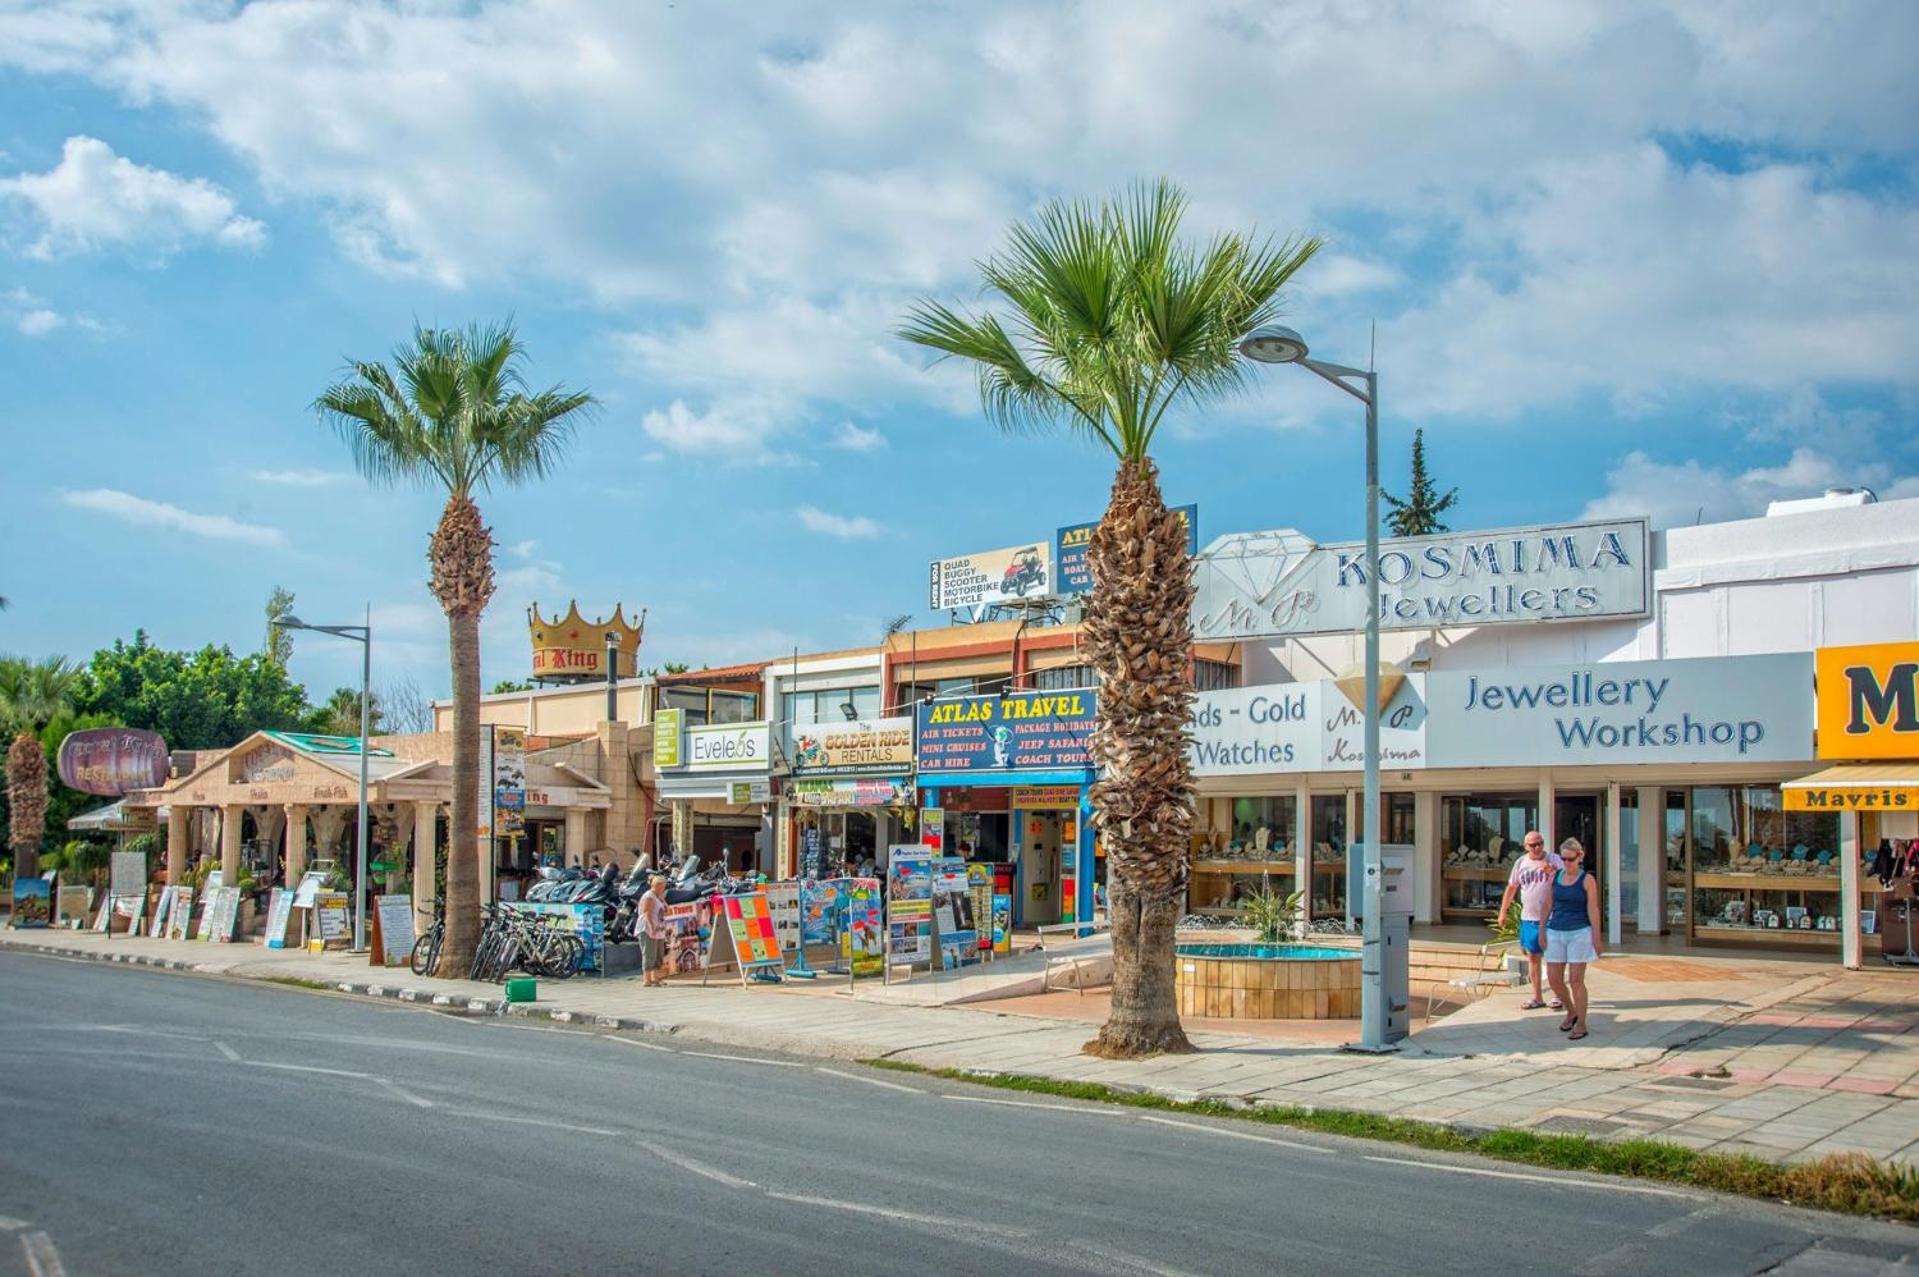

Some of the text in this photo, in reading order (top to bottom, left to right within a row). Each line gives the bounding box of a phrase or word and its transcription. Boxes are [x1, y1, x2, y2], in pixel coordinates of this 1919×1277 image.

[944, 559, 970, 571] QUAD
[1337, 531, 1630, 588] KOSMIMA
[944, 567, 977, 580] BUGGY
[944, 575, 988, 589] SCOOTER
[944, 582, 999, 598] MOTORBIKE
[944, 594, 983, 607] BICYCLE
[1379, 583, 1598, 620] Jewellers
[552, 648, 598, 670] King
[1464, 670, 1671, 713] Jewellery
[929, 695, 1085, 724] ATLAS TRAVEL
[1249, 693, 1306, 724] Gold
[859, 722, 872, 732] The
[922, 727, 984, 739] AIR TICKETS
[1015, 720, 1095, 734] PACKAGE HOLIDAYS
[1553, 713, 1766, 754] Workshop
[825, 729, 910, 750] GOLDEN RIDE
[1018, 740, 1045, 750] JEEP
[841, 748, 893, 763] RENTALS
[921, 742, 987, 754] MINI CRUISES
[1196, 740, 1294, 767] Watches
[921, 757, 971, 769] CAR HIRE
[1015, 753, 1095, 765] COACH TOURS
[1805, 790, 1908, 807] Mavris
